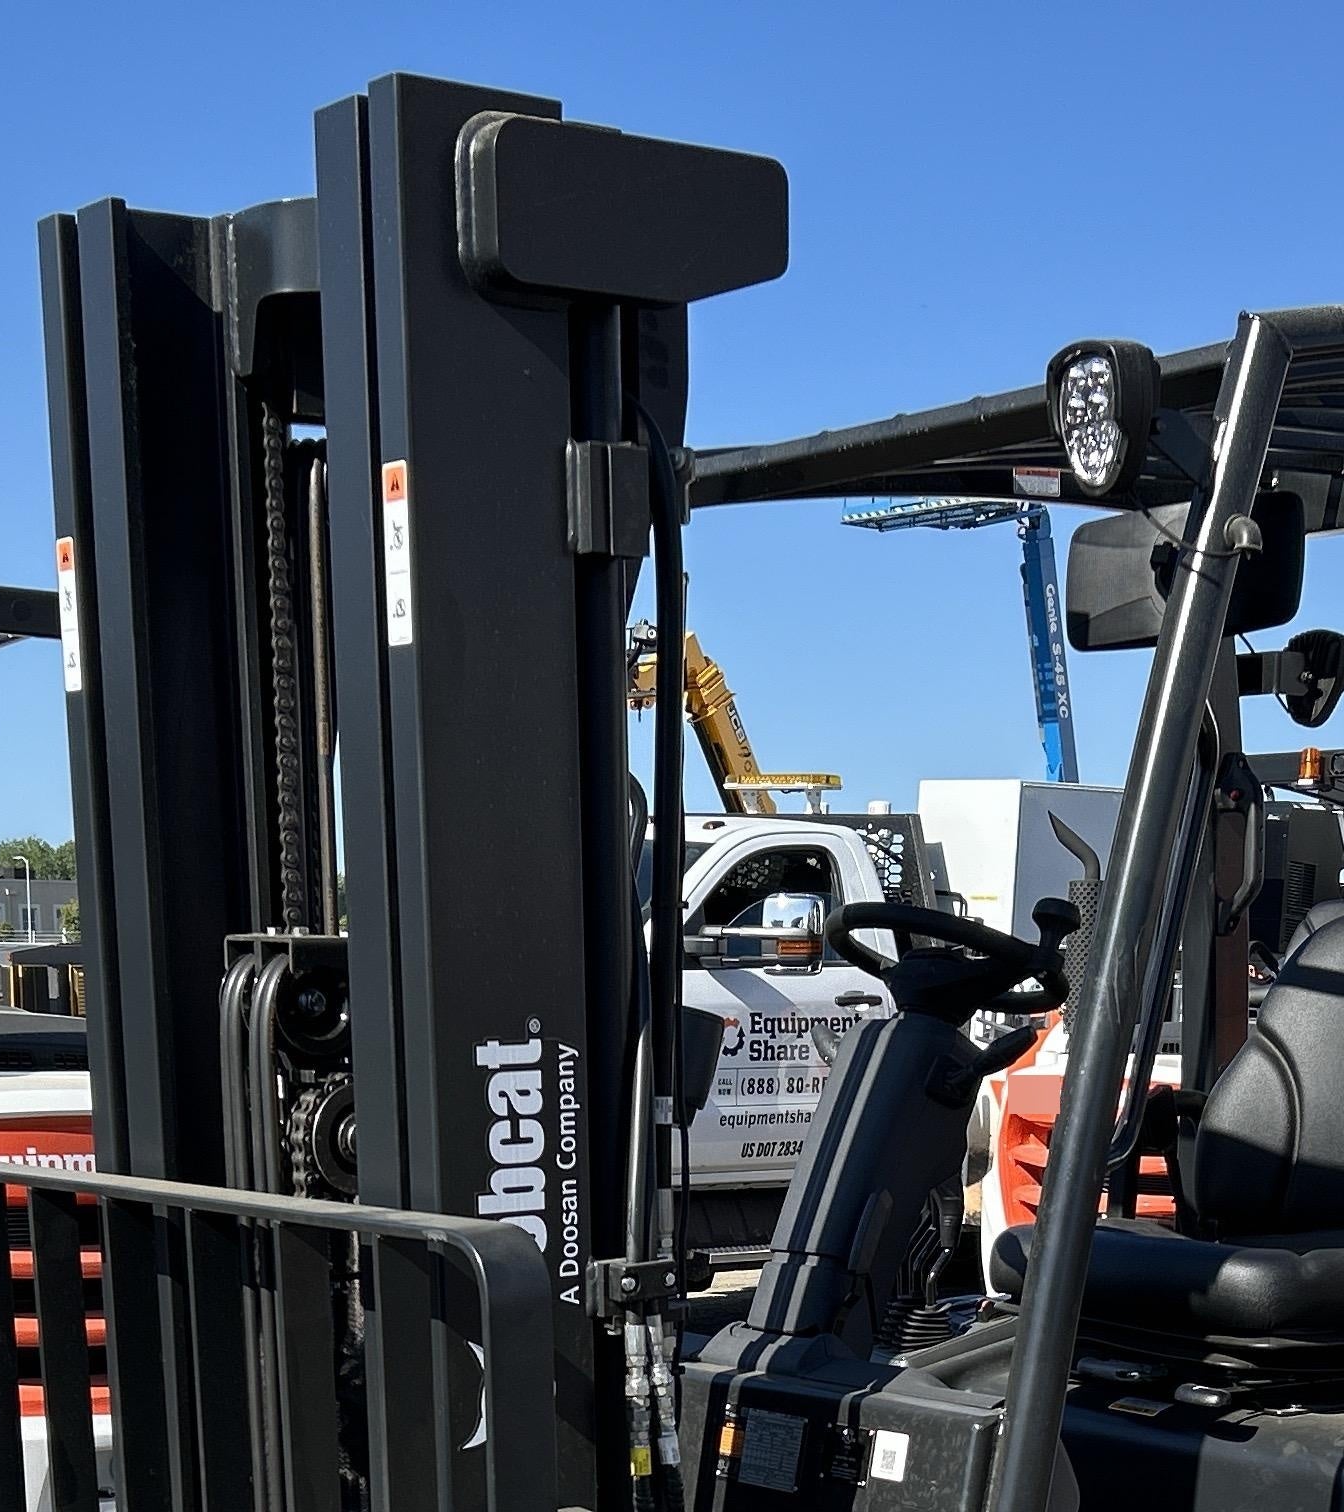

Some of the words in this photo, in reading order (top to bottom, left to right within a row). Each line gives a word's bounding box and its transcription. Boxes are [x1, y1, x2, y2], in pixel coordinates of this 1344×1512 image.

[1046, 583, 1058, 633] Genie
[1057, 691, 1069, 719] XC
[726, 700, 747, 744] JCB
[748, 1040, 810, 1062] Share
[741, 1077, 781, 1096] (888)
[556, 1043, 581, 1171] Company
[719, 1108, 814, 1129] equipmentsha
[741, 1142, 755, 1158] US
[756, 1140, 778, 1158] DOT
[559, 1178, 580, 1278] Doosan
[559, 1286, 581, 1305] A
